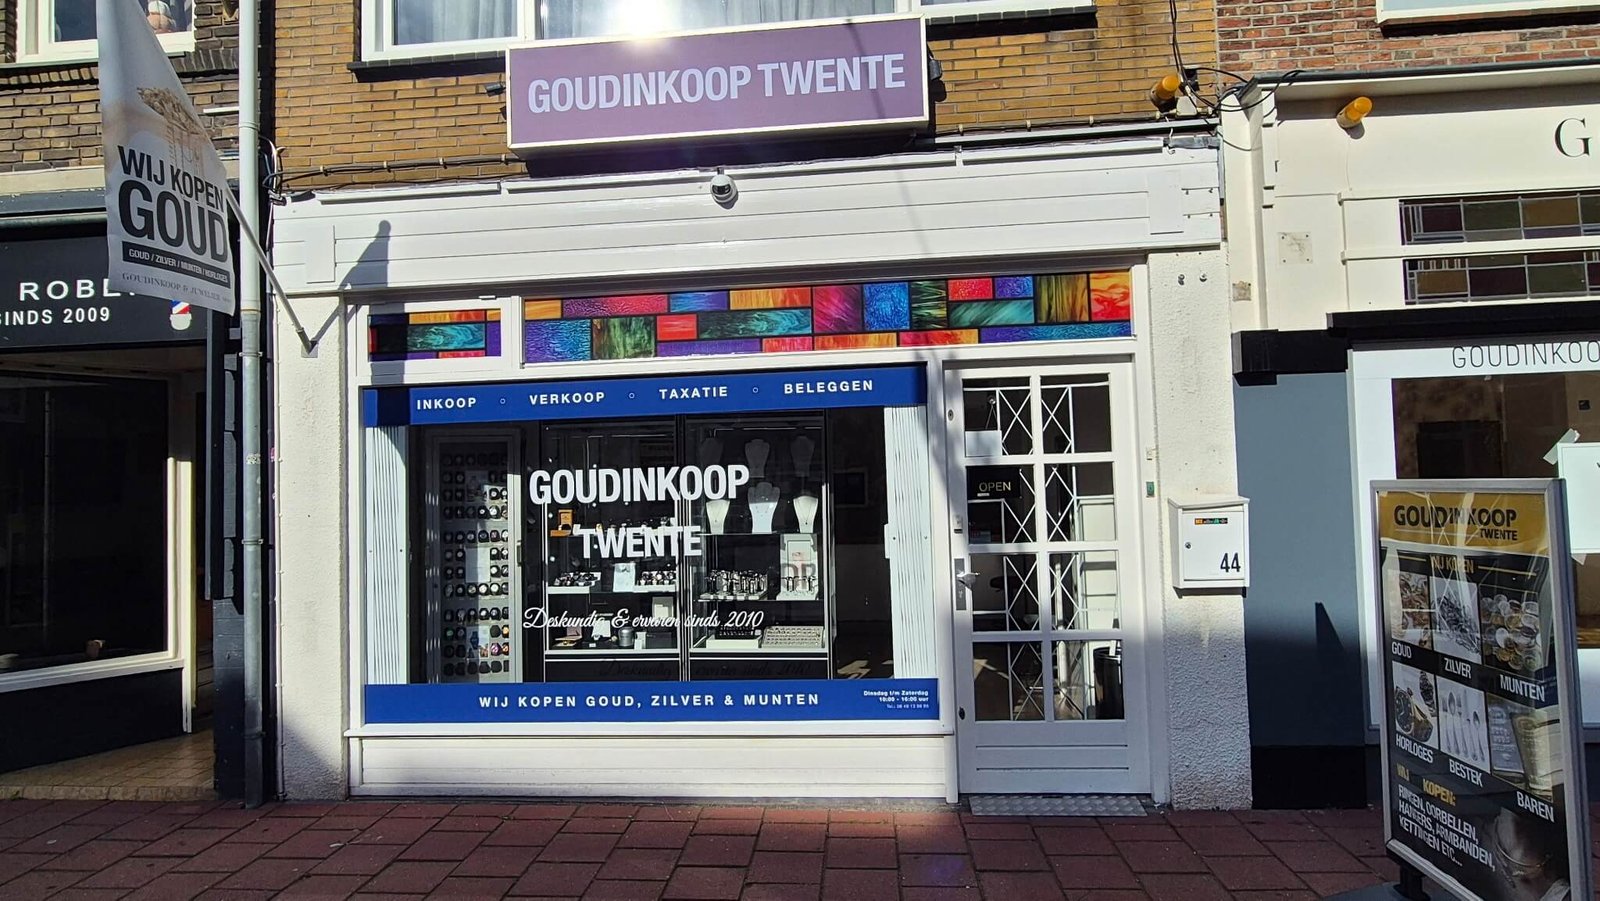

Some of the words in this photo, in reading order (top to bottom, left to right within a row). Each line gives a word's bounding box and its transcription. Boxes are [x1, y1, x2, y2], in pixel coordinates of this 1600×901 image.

[528, 65, 751, 114] GOUDINKOOP
[757, 53, 906, 98] TWENTE
[117, 145, 165, 185] WIJ
[169, 164, 224, 213] KOPEN
[118, 180, 228, 262] GOUD
[128, 248, 150, 260] GOUD
[155, 254, 177, 267] ZILVER
[0, 309, 53, 326] INDS
[62, 306, 110, 324] 2009
[659, 386, 729, 399] TAXATIE
[784, 380, 874, 394] BELEGGEN
[416, 397, 478, 411] INKOOP
[529, 391, 606, 405] VERKOOP
[529, 464, 750, 505] GOUDINKOOP
[978, 481, 1012, 493] OPEN
[578, 525, 703, 559] TWENTE
[1480, 528, 1518, 541] TWENTE
[1220, 552, 1241, 572] 44
[611, 608, 630, 629] &
[684, 610, 721, 627] sinds
[724, 610, 764, 628] 2010
[1391, 641, 1412, 660] GOUD
[1444, 656, 1472, 679] ZILVER
[1500, 674, 1545, 702] MUNTEN
[479, 697, 509, 708] WIJ
[518, 697, 577, 707] KOPEN
[585, 696, 642, 709] GOUD,
[650, 695, 715, 706] ZILVER
[724, 696, 734, 705] &
[744, 694, 819, 706] MUNTEN
[1395, 733, 1434, 764] HORLOGES
[1449, 758, 1483, 788] BESTEK
[1423, 778, 1456, 806] KOPEN:
[1516, 790, 1555, 823] BAREN
